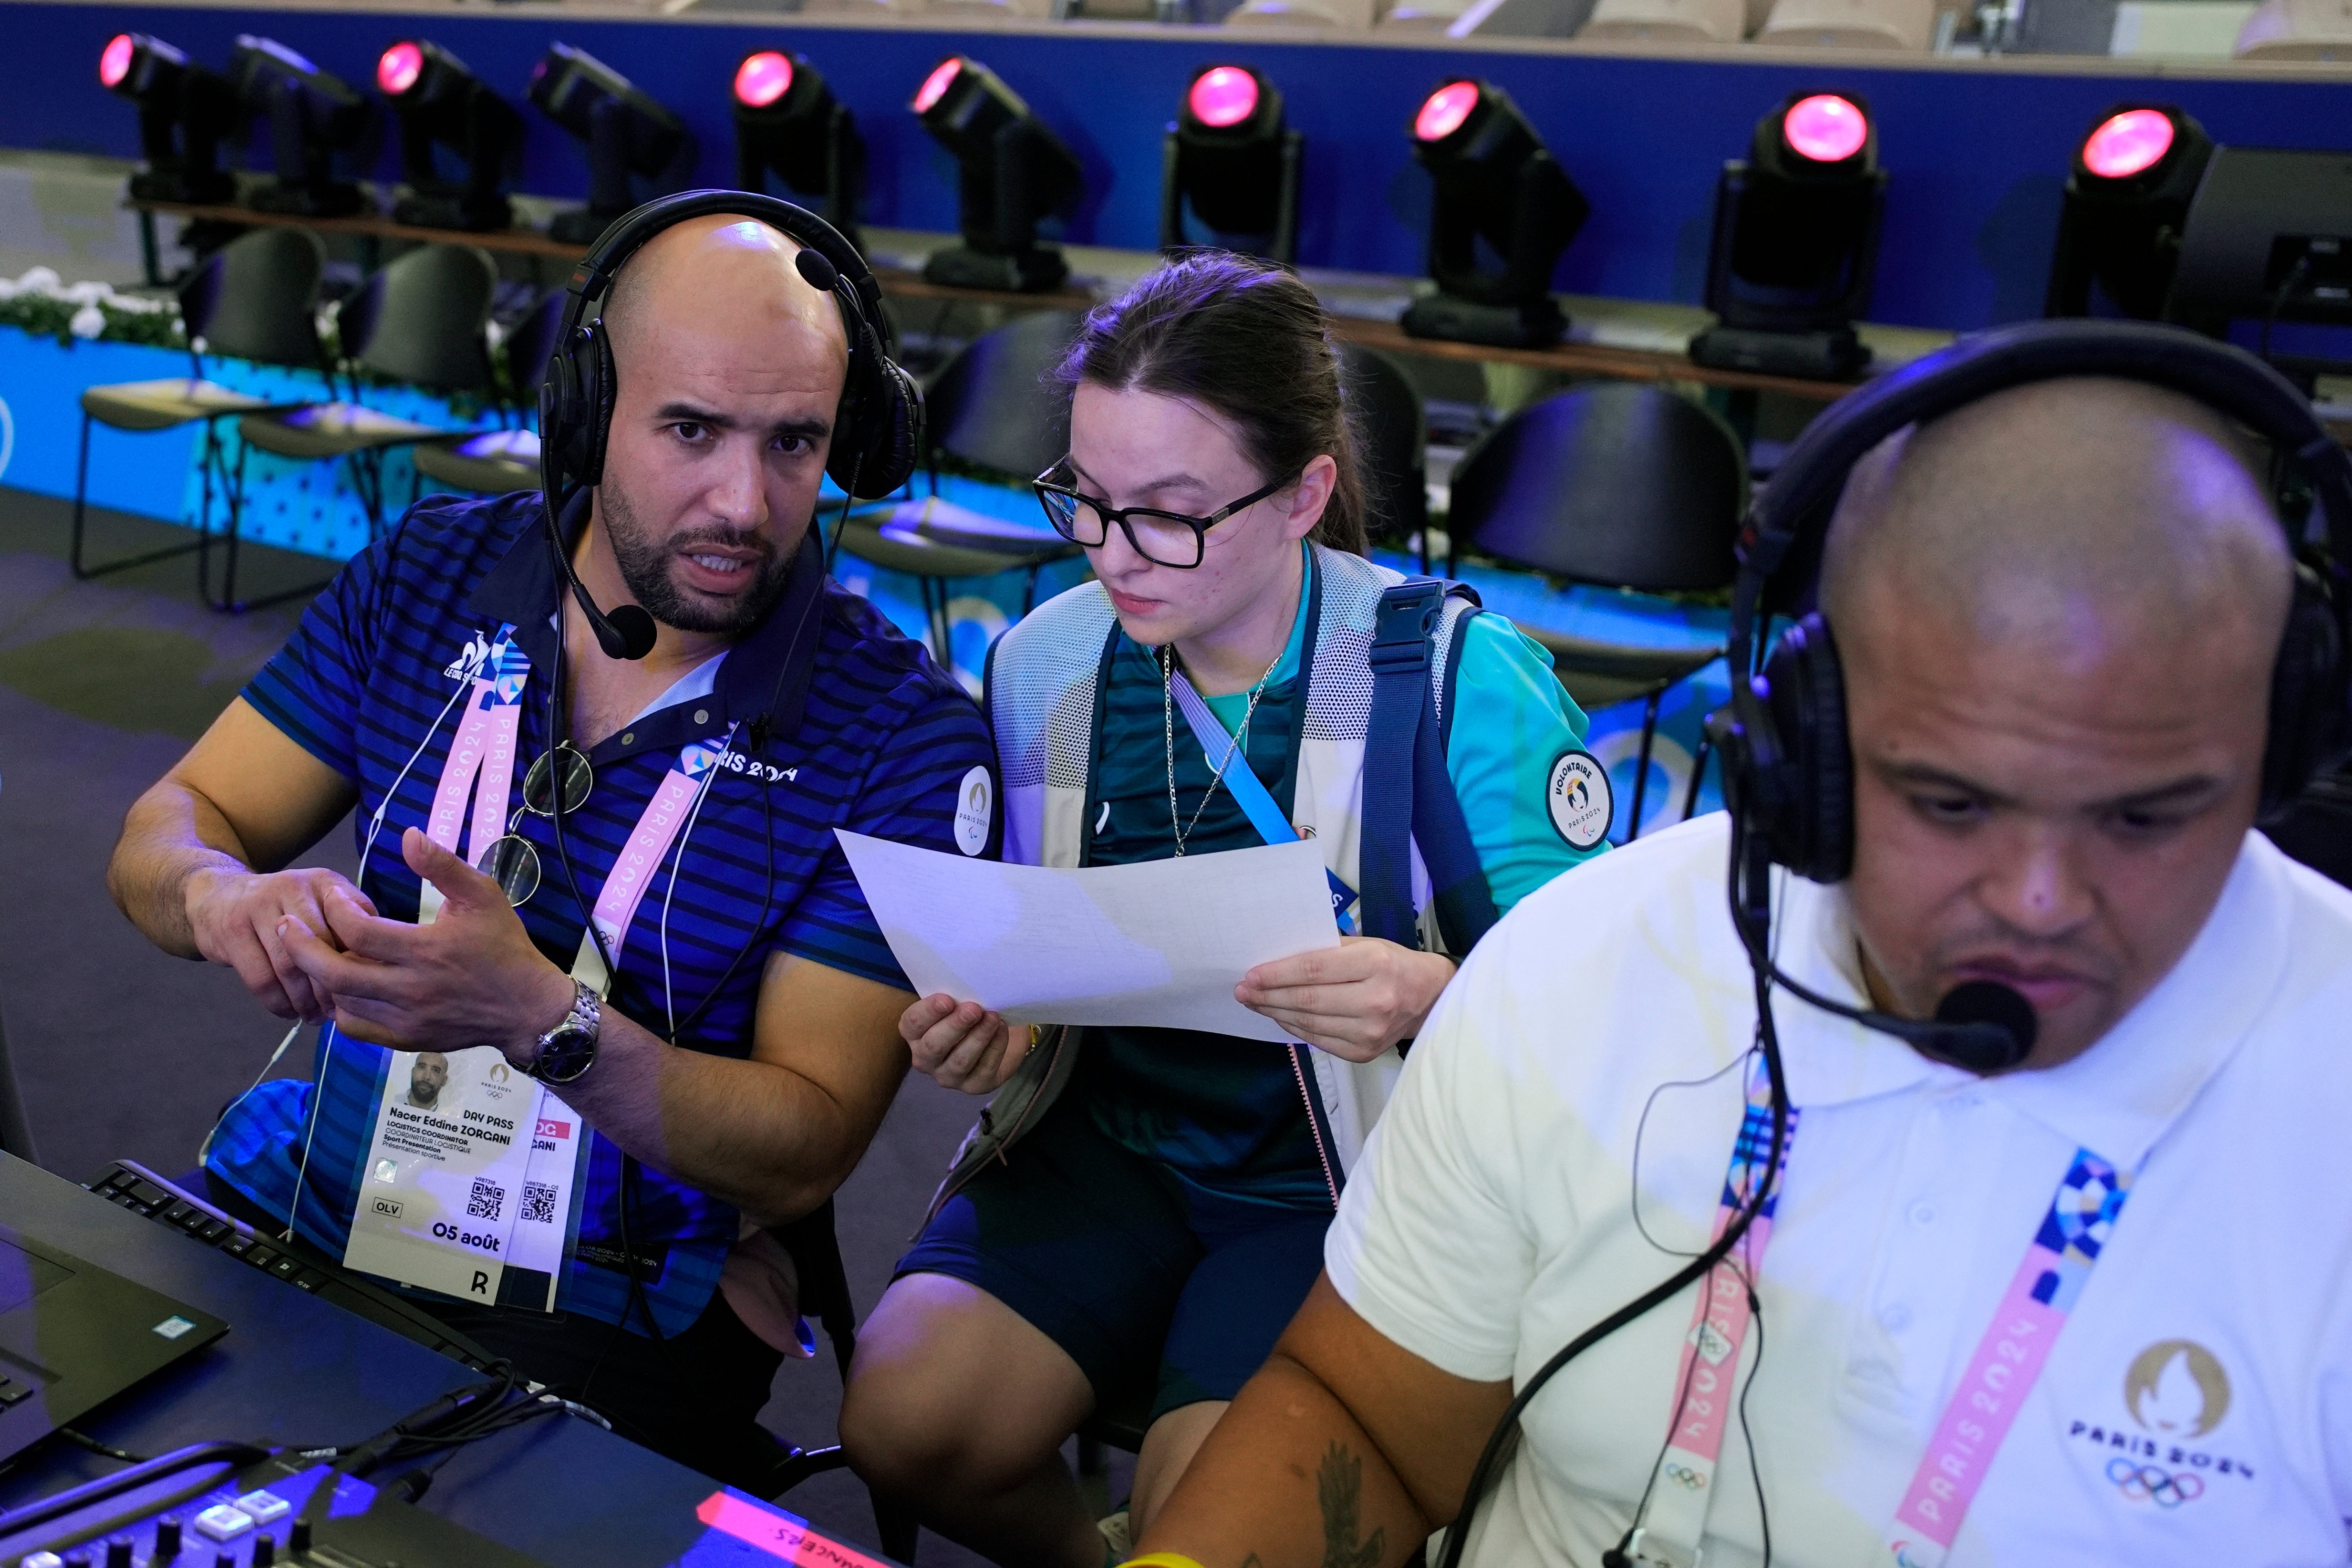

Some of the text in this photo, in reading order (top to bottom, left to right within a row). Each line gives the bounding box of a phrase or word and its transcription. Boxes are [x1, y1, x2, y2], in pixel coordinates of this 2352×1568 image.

[454, 722, 486, 778] 2024
[1555, 762, 1593, 795] VOLONTAIRE
[1585, 806, 1601, 820] 2024
[605, 851, 644, 911] 2024
[387, 1120, 468, 1145] LOGISTICS COORDINATOR
[390, 1107, 511, 1145] Nacer Eddine ZORGANI
[464, 1110, 514, 1130] DAY PASS
[382, 1140, 446, 1162] Présentation sportive
[383, 1134, 441, 1153] Sport Presentation
[385, 1128, 472, 1154] COORDINATEUR LOGISTIQUE
[475, 1176, 496, 1185] 4987318
[376, 1202, 400, 1214] OLV
[461, 1234, 500, 1252] août
[471, 1270, 488, 1295] R
[1917, 1318, 2039, 1522] PARIS 2024
[2168, 1445, 2255, 1479] 2024
